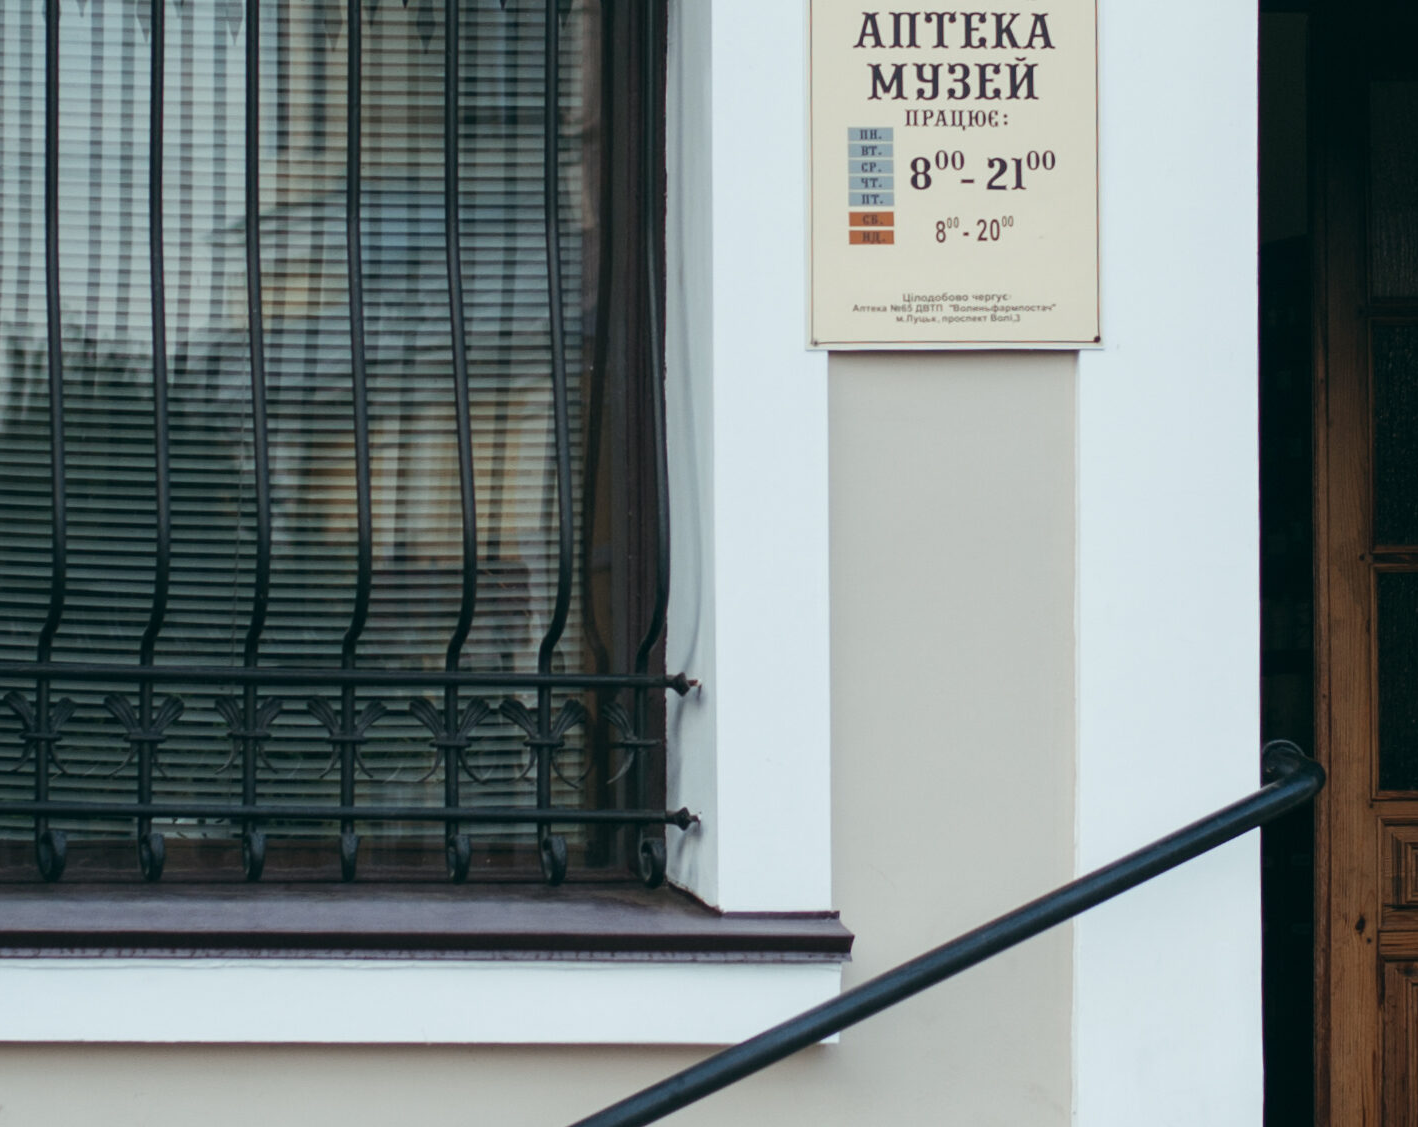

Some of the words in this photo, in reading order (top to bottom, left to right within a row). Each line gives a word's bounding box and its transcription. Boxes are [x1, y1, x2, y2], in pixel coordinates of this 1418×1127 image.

[852, 11, 1056, 50] АПТЕКА
[866, 57, 1040, 101] МУЗЕЙ
[904, 109, 1010, 131] ПРАЦЮЄ:
[859, 129, 882, 140] ПН.
[860, 145, 882, 156] ВТ.
[860, 162, 882, 173] СР.
[860, 177, 883, 189] ЧТ.
[861, 193, 884, 205] ПТ.
[852, 304, 887, 313] Аптека
